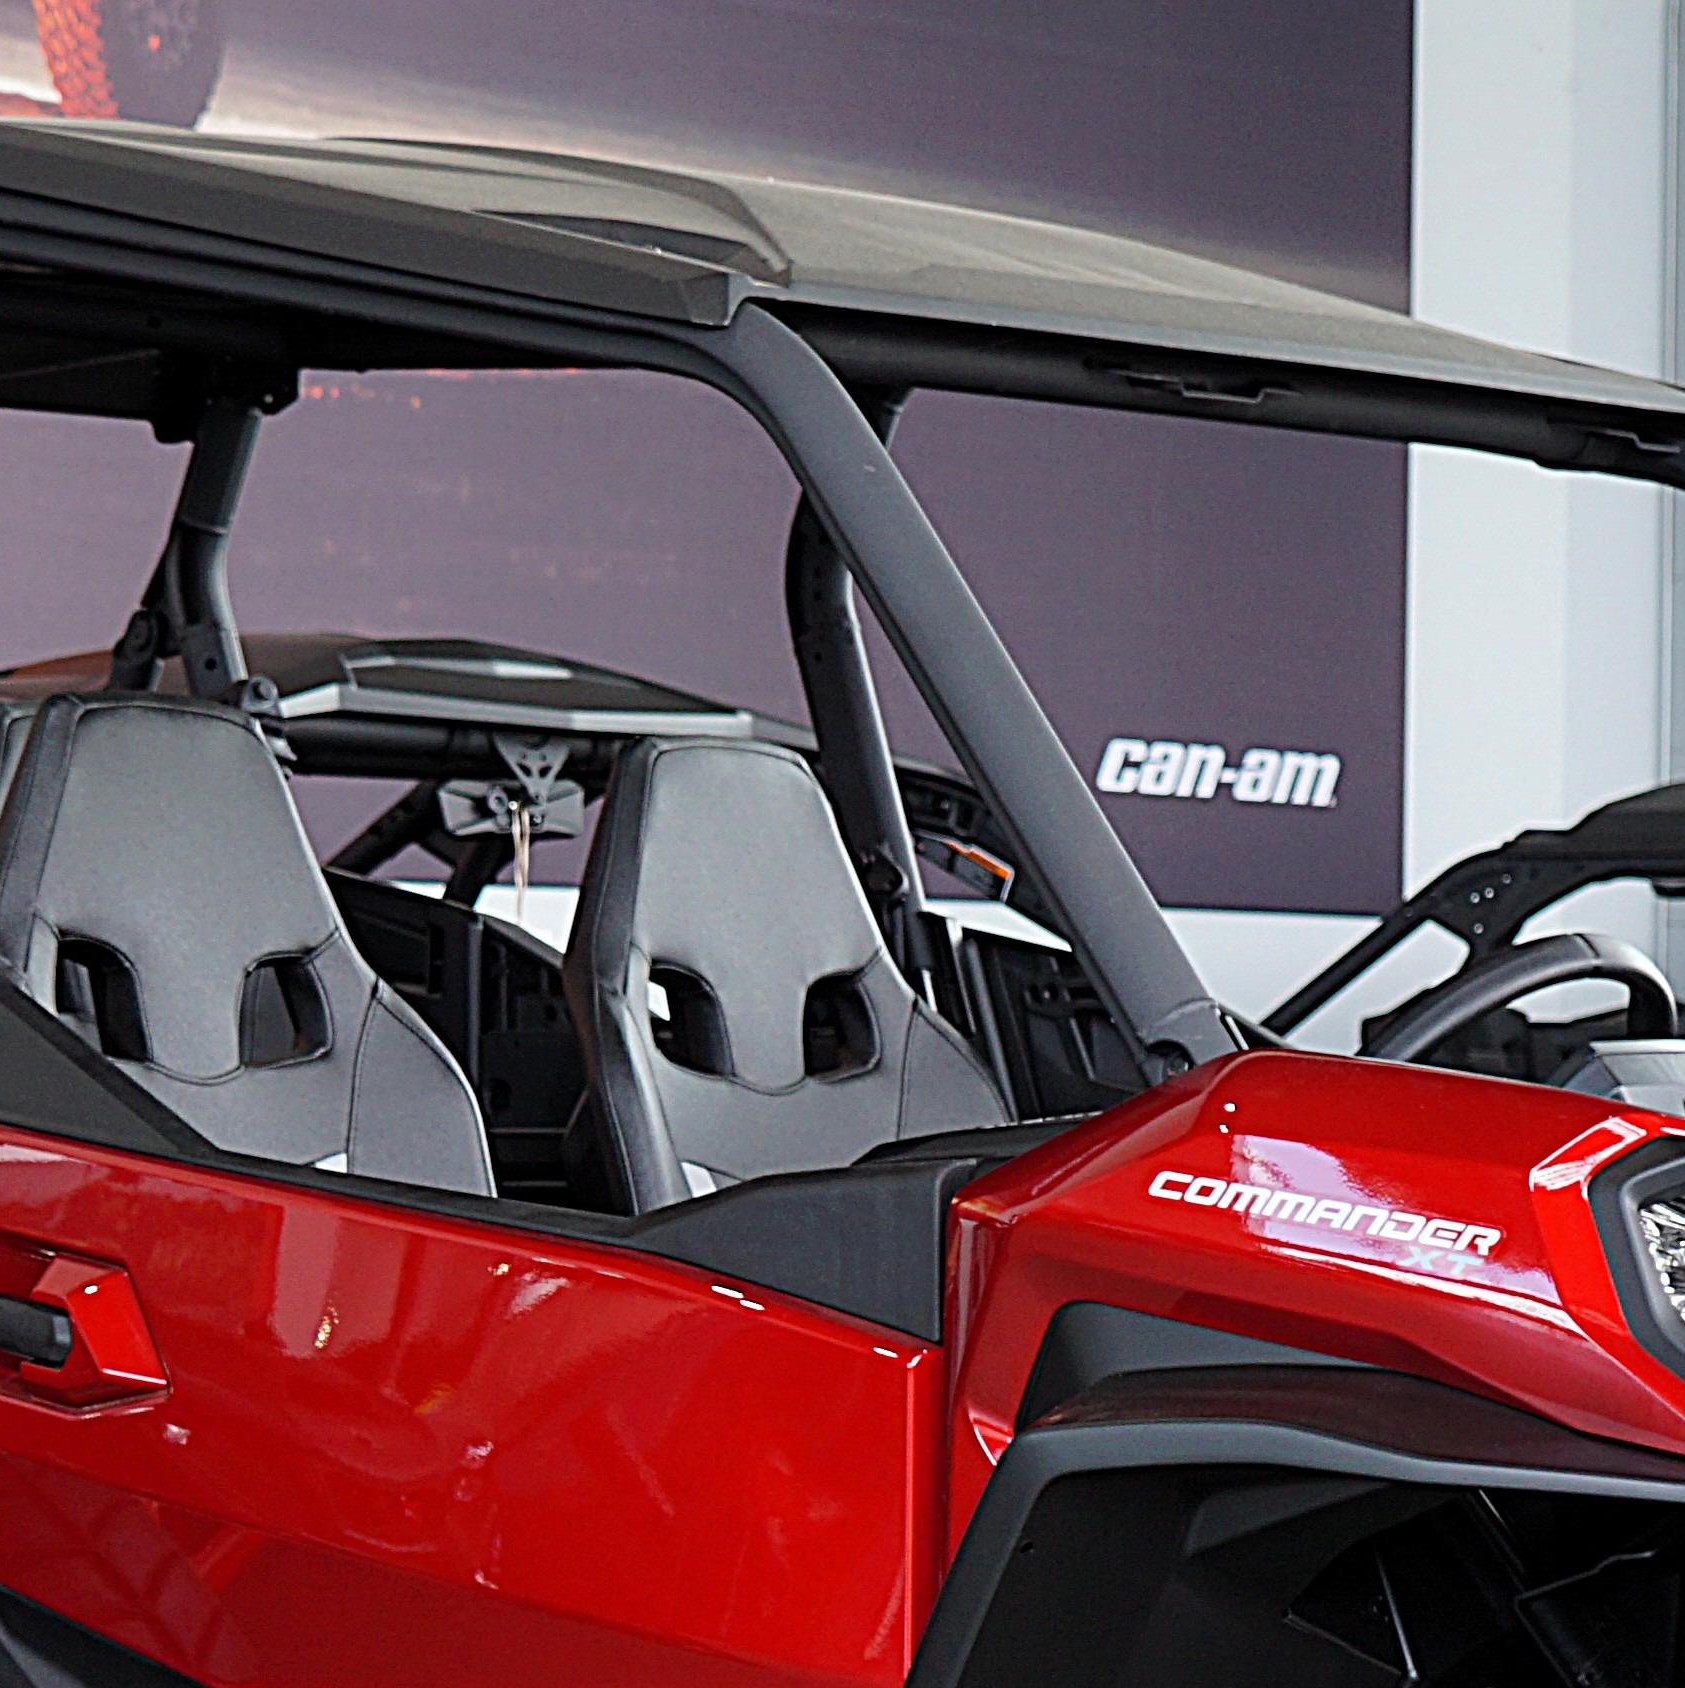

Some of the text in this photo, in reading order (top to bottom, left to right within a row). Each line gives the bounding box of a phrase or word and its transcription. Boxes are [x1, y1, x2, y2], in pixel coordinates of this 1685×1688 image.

[1096, 738, 1341, 808] can-am
[1148, 1170, 1502, 1256] COMMANDER
[1397, 1245, 1484, 1275] XT
